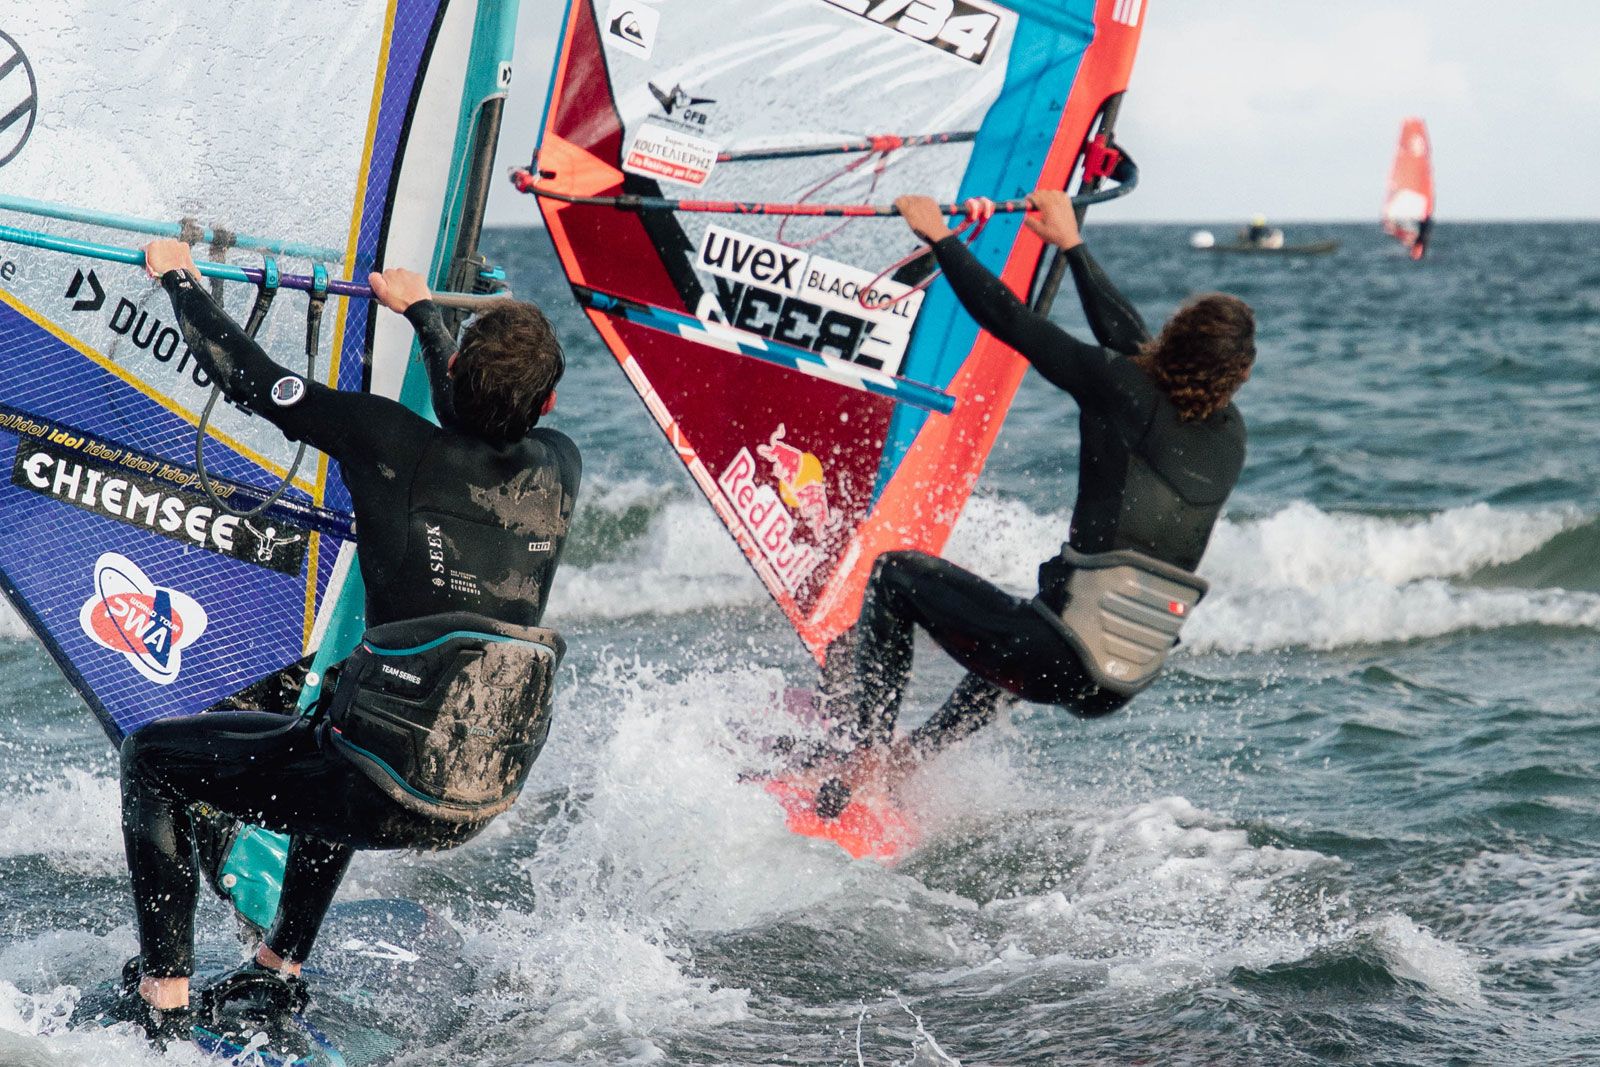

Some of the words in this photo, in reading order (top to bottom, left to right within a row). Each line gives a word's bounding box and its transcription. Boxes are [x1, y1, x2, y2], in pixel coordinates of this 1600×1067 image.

[703, 232, 799, 289] uvex
[13, 416, 49, 436] idol
[47, 428, 85, 449] idol
[83, 440, 122, 462] idol
[120, 451, 159, 473] idol
[157, 463, 198, 486] idol
[22, 452, 240, 551] CHIEMSEE
[723, 453, 777, 529] Red
[425, 522, 445, 574] SEEK
[104, 597, 168, 653] PWA
[159, 615, 180, 632] TOUR
[382, 663, 399, 677] TEAM
[398, 669, 422, 685] SERIES
